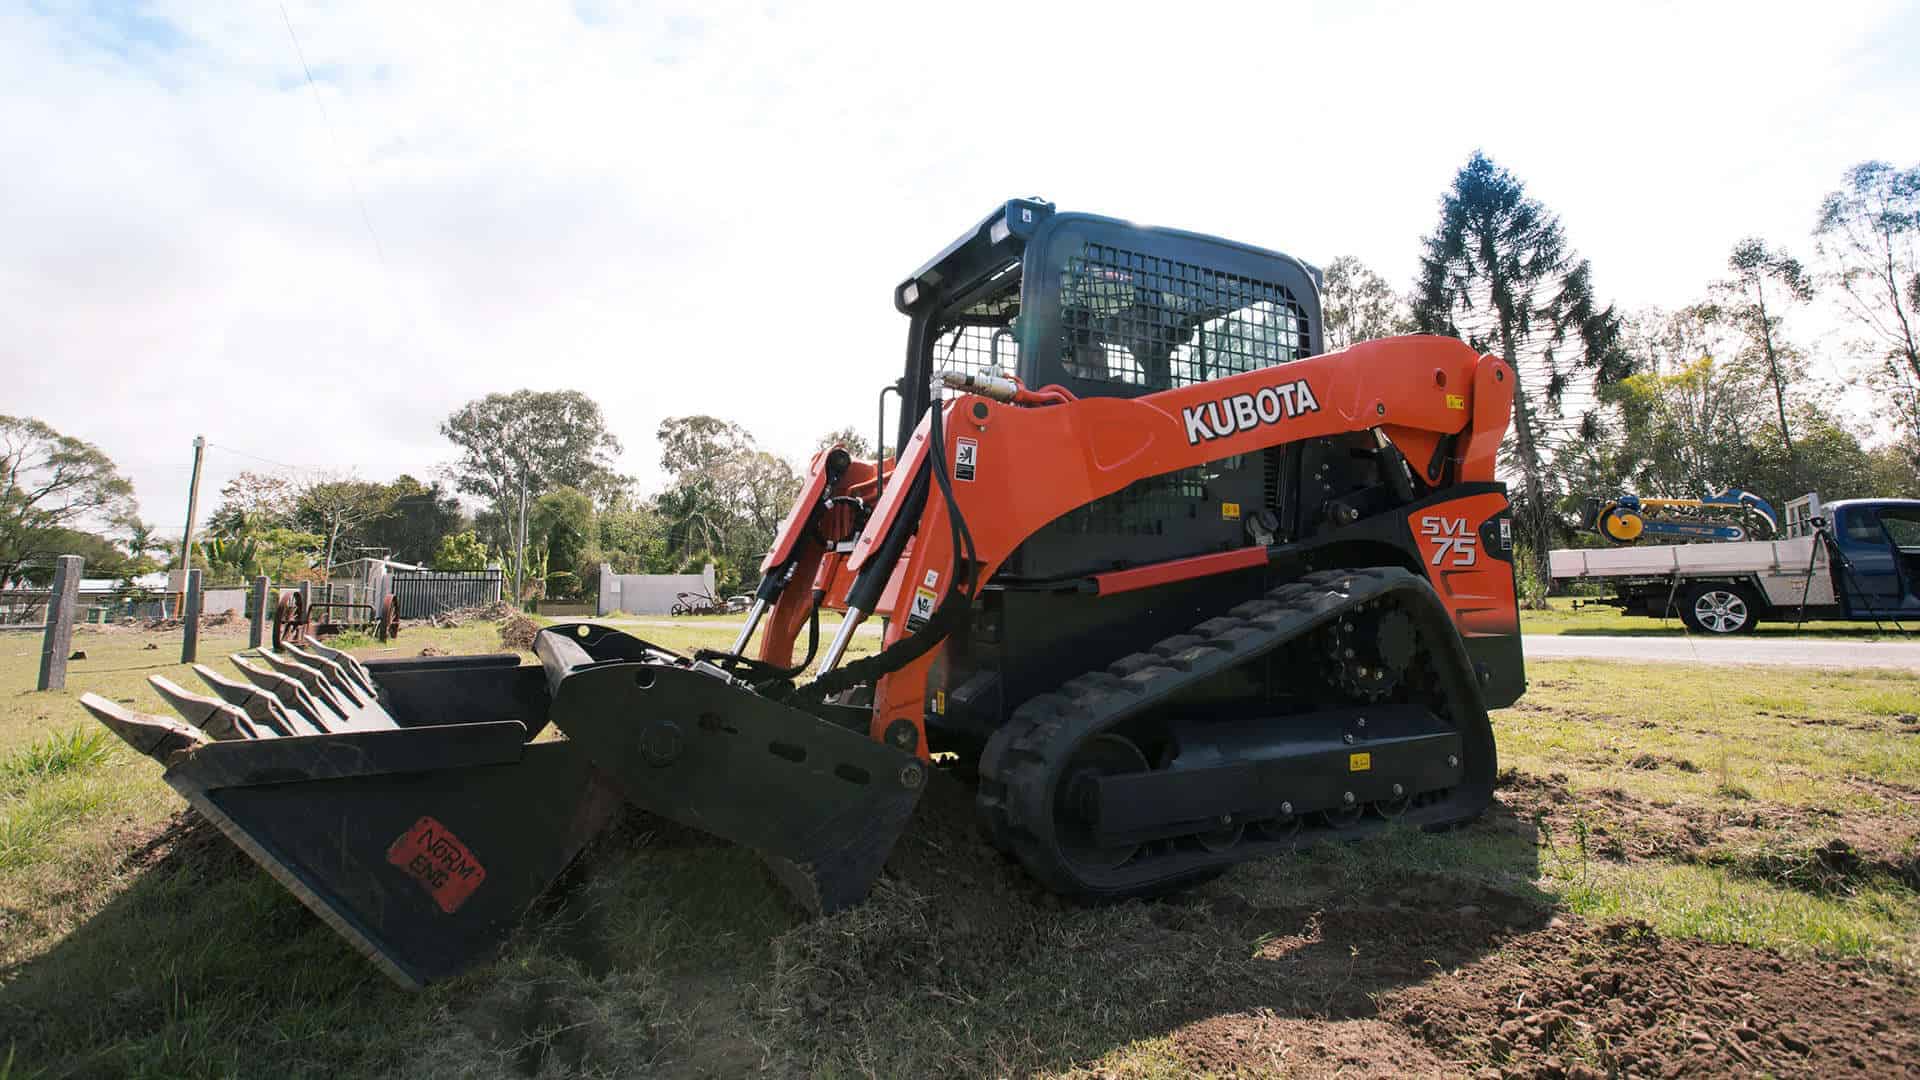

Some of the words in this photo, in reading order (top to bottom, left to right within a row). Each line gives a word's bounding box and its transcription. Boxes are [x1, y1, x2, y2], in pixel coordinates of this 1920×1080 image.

[1182, 379, 1320, 445] KUBOTA
[1420, 516, 1477, 537] SVL
[1431, 537, 1476, 567] 75
